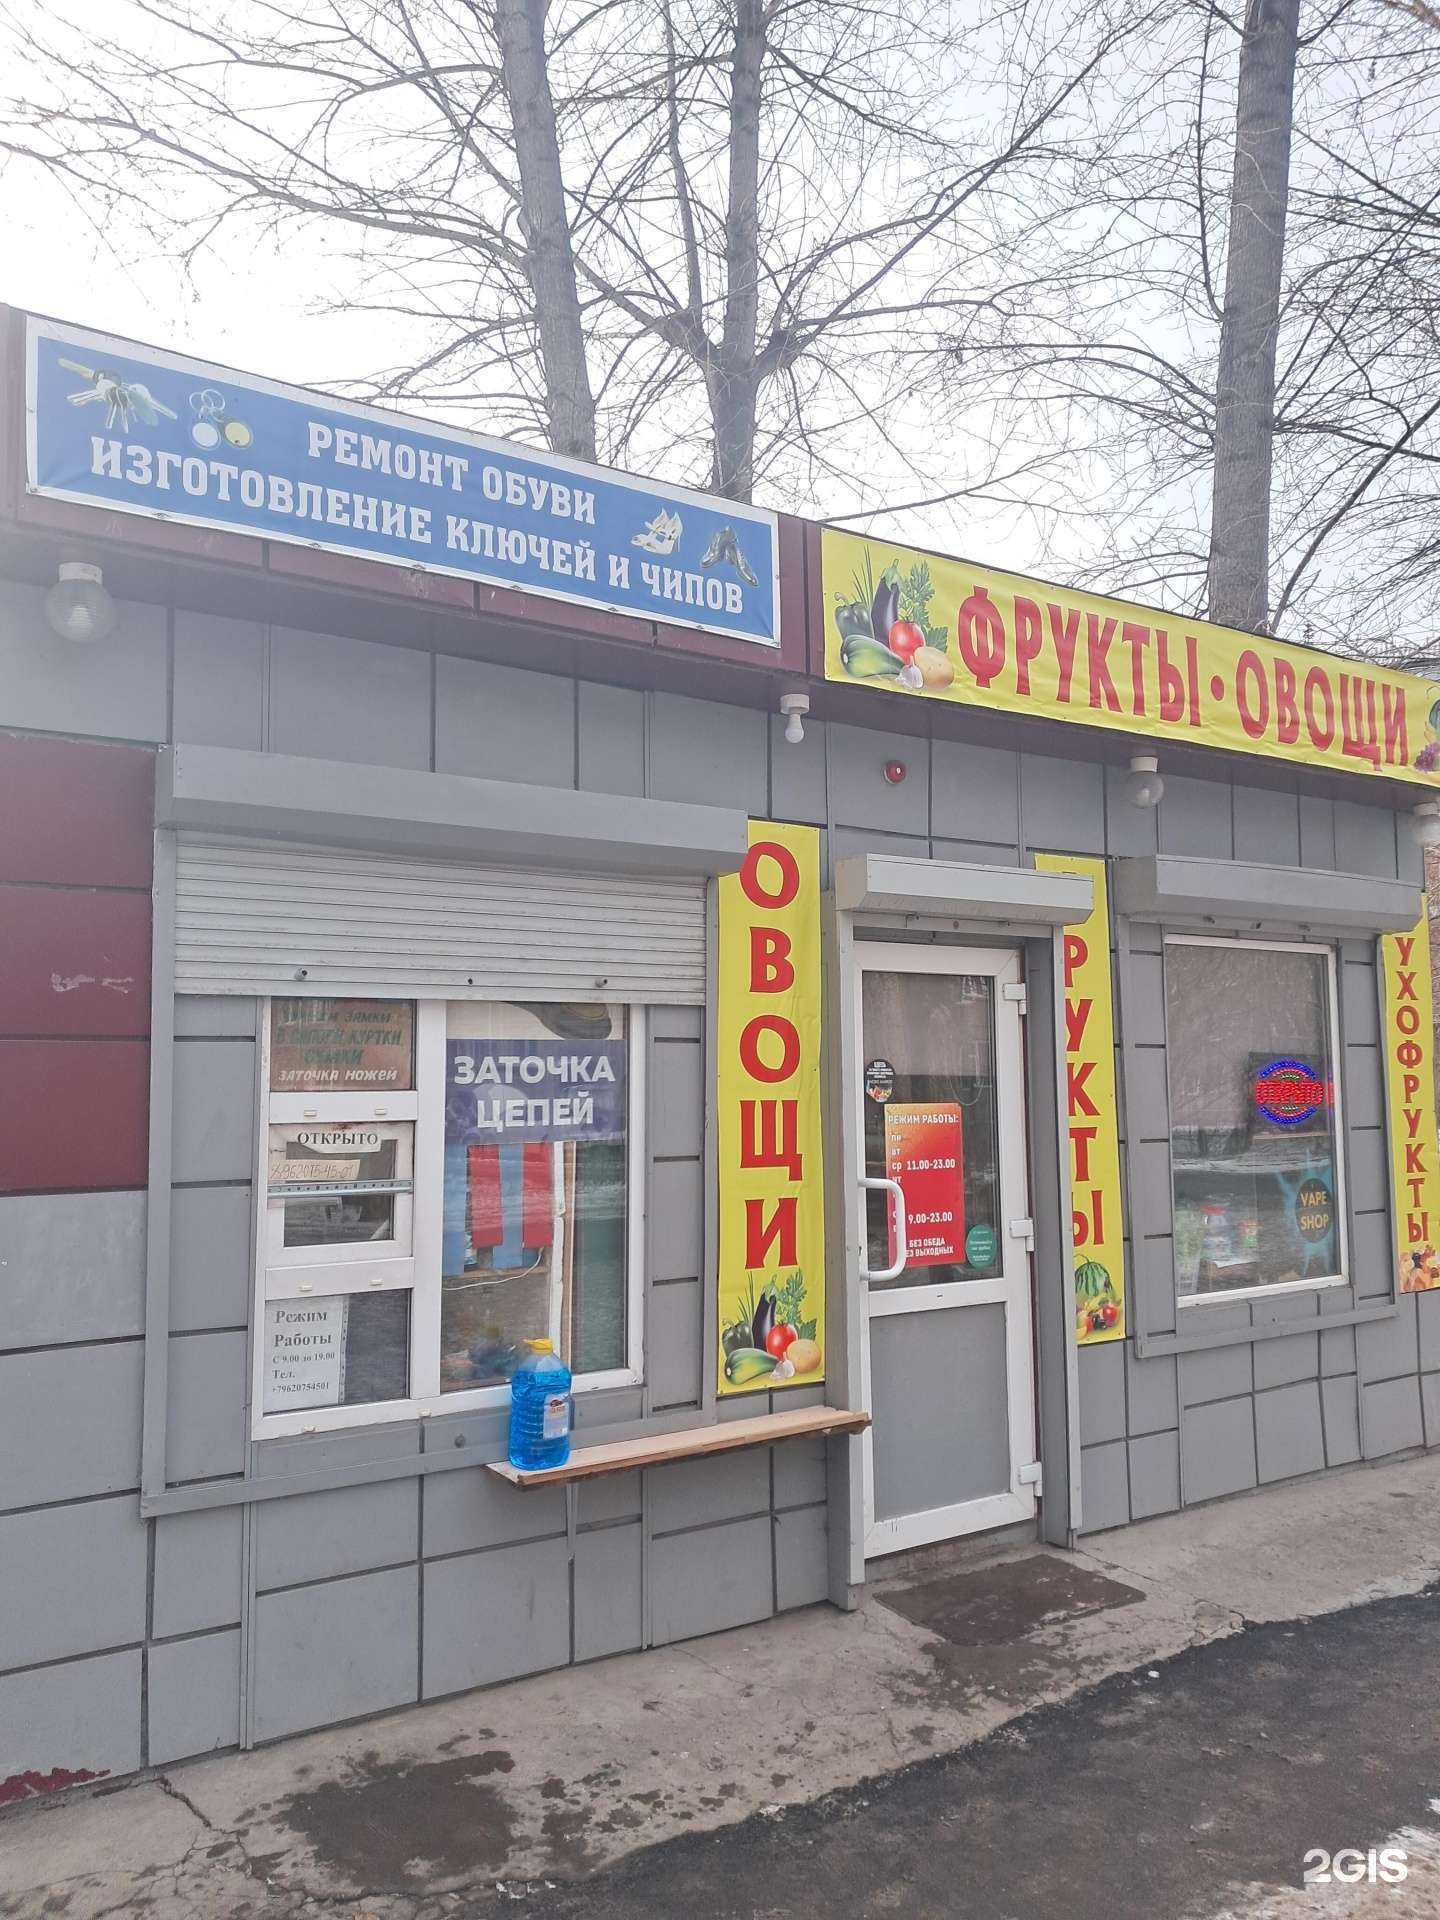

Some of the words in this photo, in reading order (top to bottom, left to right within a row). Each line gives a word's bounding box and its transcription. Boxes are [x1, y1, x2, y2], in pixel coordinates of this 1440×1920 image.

[307, 420, 470, 493] РЕМОНТ
[482, 468, 597, 526] ОБУВИ
[90, 436, 433, 545] ИЗГОТОВЛЕНИЕ
[446, 513, 597, 583] КЛЮЧЕЙ
[608, 553, 631, 590] И
[641, 559, 745, 615] ЧИПОВ
[957, 585, 1203, 728] ФРУКТЫ
[1235, 649, 1410, 773] ОВОЩИ
[739, 841, 803, 1270] ОВОЩИ
[453, 1055, 616, 1085] ЗАТОЧКА
[1063, 934, 1104, 1246] РУКТЫ
[1394, 936, 1430, 1244] УХОФРУКТЫ
[477, 1091, 594, 1133] ЦЕПЕЙ
[888, 1114, 920, 1125] РЕЖИМ
[922, 1113, 960, 1124] РАБОТЫ:
[297, 1132, 379, 1145] ОТКРЫТО
[907, 1158, 956, 1171] 11.00-23.00
[1300, 1191, 1328, 1207] VAPE
[908, 1211, 953, 1225] 9.00-23.00
[1300, 1214, 1329, 1231] SHOP
[909, 1239, 922, 1248] БЕЗ
[923, 1237, 946, 1247] ОБЕДА
[273, 1310, 328, 1324] Режим
[274, 1333, 332, 1347] Работы
[272, 1369, 296, 1379] Тел.
